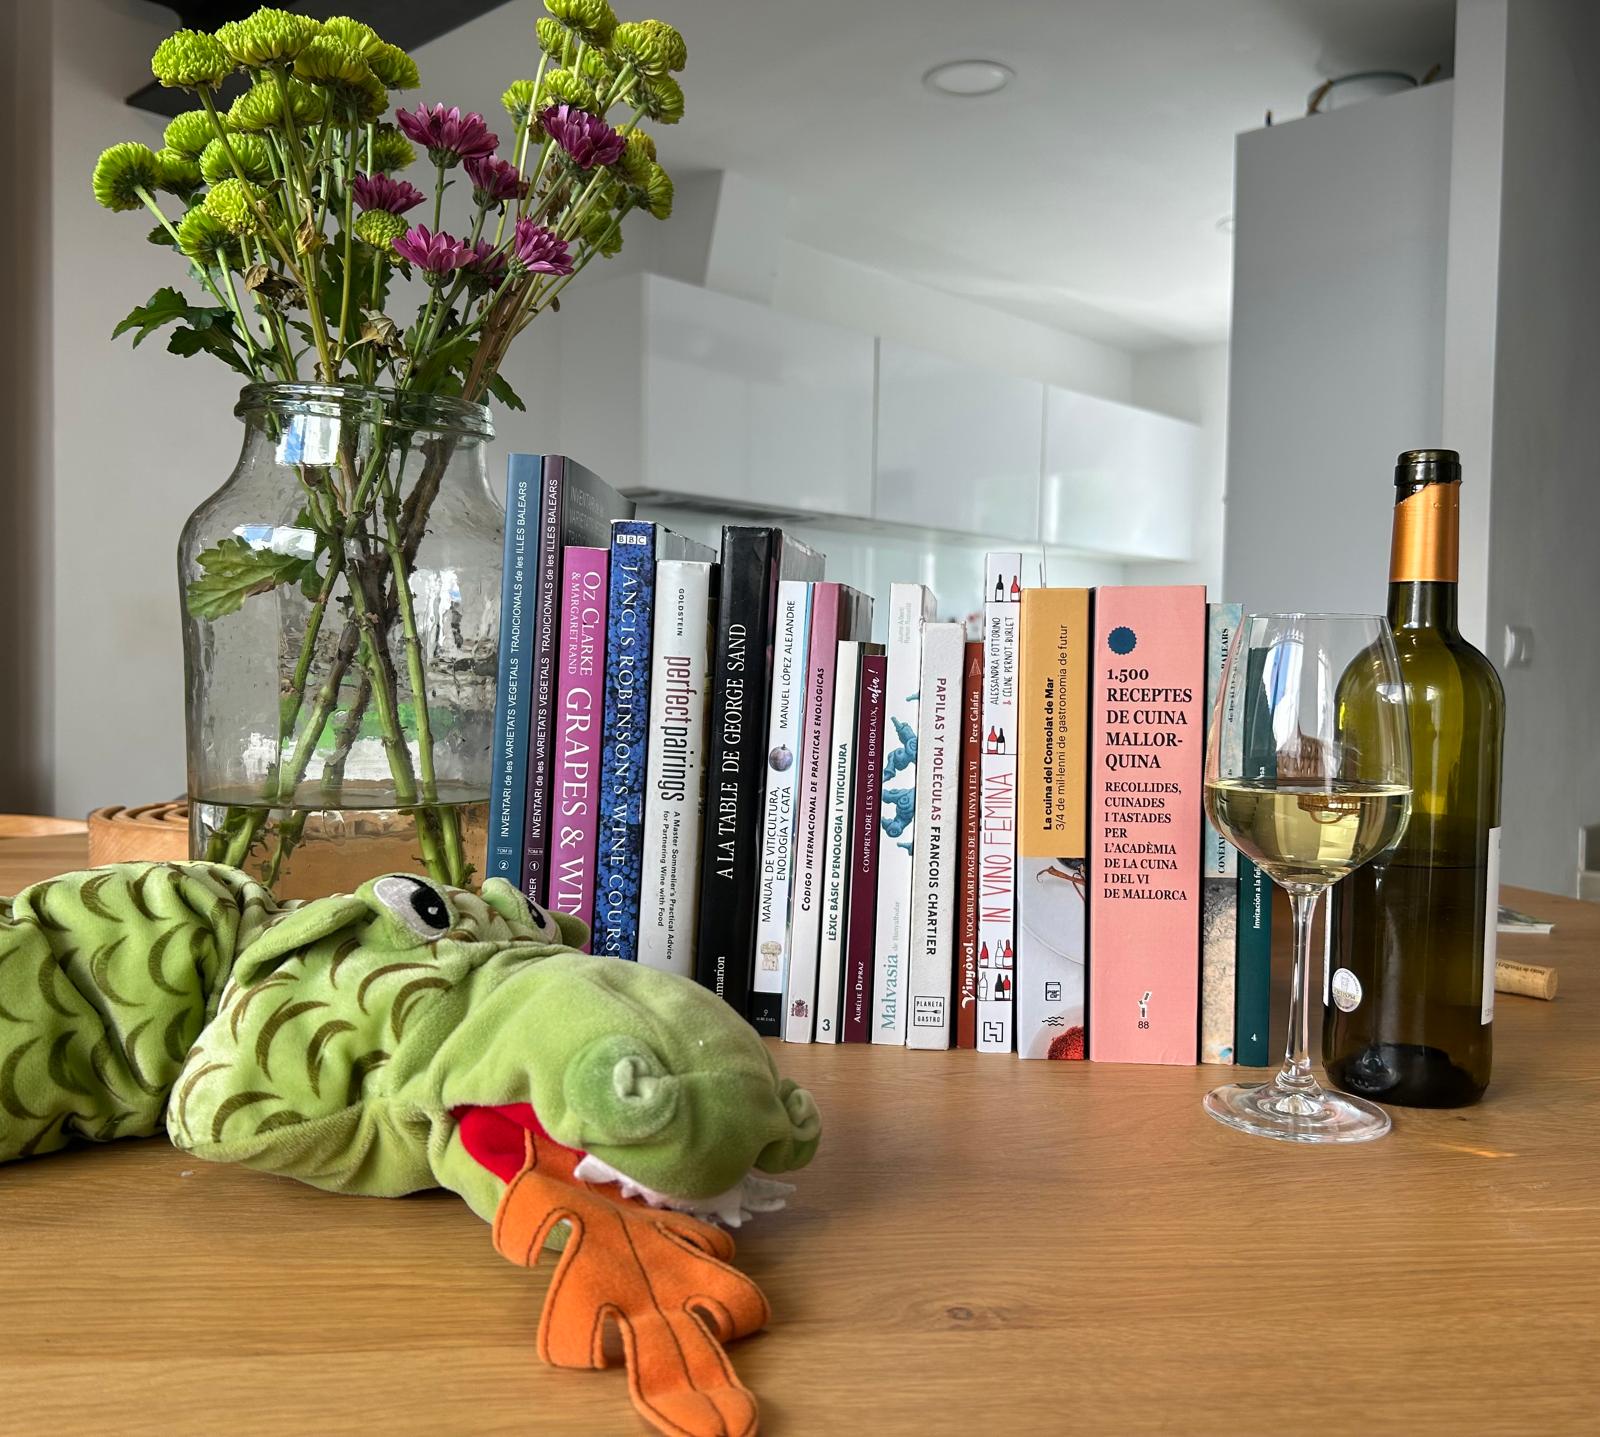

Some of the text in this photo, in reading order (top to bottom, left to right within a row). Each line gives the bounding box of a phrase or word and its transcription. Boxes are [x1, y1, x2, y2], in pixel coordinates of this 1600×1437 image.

[517, 481, 527, 526] BALEARS
[547, 479, 558, 524] BALEARS
[516, 528, 525, 554] ILLES
[546, 526, 556, 552] ILLES
[616, 534, 646, 546] BBC
[515, 556, 524, 569] les
[546, 554, 555, 567] les
[514, 570, 523, 582] de
[545, 569, 554, 580] de
[510, 583, 523, 653] TRADICIONALS
[541, 582, 553, 653] TRADICIONALS
[568, 572, 581, 675] & MARGARET RAND
[579, 571, 601, 676] OZ CLARKE
[676, 588, 685, 637] GOLDSTEIN
[1057, 624, 1068, 650] futur
[779, 601, 795, 729] MANUEL LÓPEZ ALEJANDRE
[991, 617, 1001, 705] ALESSANDRA FOTTORINO
[1057, 652, 1068, 666] de
[508, 658, 519, 707] VEGETALS
[539, 657, 550, 707] VEGETALS
[1107, 668, 1149, 684] 1.500
[814, 668, 825, 726] ENOLÓGICAS
[1057, 668, 1068, 733] gastronomia
[1107, 688, 1192, 703] RECEPTES
[658, 656, 698, 802] perfect pairings
[970, 691, 980, 743] Pere Calafat
[1106, 710, 1188, 725] DE CUINA
[505, 708, 516, 759] VARIETATS
[536, 708, 547, 759] VARIETATS
[868, 706, 878, 756] BORDEAUX,
[1056, 735, 1066, 749] de
[1106, 732, 1183, 747] MALLOR-
[605, 564, 637, 960] JANCIS ROBINSON'S WINE COURS
[716, 624, 746, 879] A LA TABLE DE GEORGE SAND
[811, 729, 821, 778] PRÁCTICAS
[1043, 677, 1054, 830] La cuina del Consolat de Mar
[1105, 754, 1162, 772] QUINA
[504, 760, 513, 773] les
[535, 761, 544, 773] les
[836, 743, 848, 806] VITICULTURA
[868, 760, 875, 771] DE
[969, 772, 977, 784] EL
[970, 761, 977, 771] VI
[504, 774, 513, 786] de
[535, 775, 544, 786] de
[810, 780, 818, 793] DE
[866, 773, 874, 793] VINS
[1105, 782, 1182, 794] RECOLLIDES,
[500, 788, 512, 837] INVENTARI
[532, 788, 543, 838] INVENTARI
[557, 687, 592, 916] GRAPES & WIN
[968, 791, 977, 819] VINYA
[1055, 797, 1066, 811] de
[1104, 797, 1165, 808] CUINADES
[926, 678, 946, 955] PAPILAS Y MOLÉCULAS FRANÇOIS CHARTIER
[968, 821, 976, 833] LA
[1055, 813, 1066, 831] 3/4
[1105, 812, 1172, 824] I TASTADES
[659, 823, 669, 864] Partnering
[672, 819, 680, 847] Master
[776, 786, 791, 881] ENOLOGÍA Y CATA
[806, 796, 817, 869] INTERNACIONAL
[862, 814, 872, 873] COMPRENDRE
[968, 835, 976, 848] DE
[1104, 827, 1128, 838] PER
[762, 786, 780, 922] MANUAL DE VITICULTURA,
[832, 815, 843, 879] D'ENOLOGIA
[982, 772, 1013, 923] IN VINO FEMINA
[1104, 841, 1177, 855] L'ACADÈMIA
[669, 849, 679, 897] Sommelier's
[1104, 858, 1178, 870] DE LA CUINA
[528, 878, 537, 902] ONER
[1104, 873, 1149, 884] I DEL VI
[1104, 888, 1188, 901] DE MALLORCA
[657, 907, 665, 927] Food
[668, 899, 676, 932] Practical
[966, 880, 975, 938] VOCABULARI
[1252, 893, 1261, 929] Invitación
[827, 914, 838, 941] LÈXIC
[666, 934, 674, 960] Advice
[713, 956, 726, 1000] mmarion
[881, 952, 898, 1030] Malvasia
[916, 1000, 942, 1008] PLANETA
[822, 1018, 831, 1032] 3
[917, 1015, 941, 1023] GASTRO
[1138, 1020, 1150, 1030] 88
